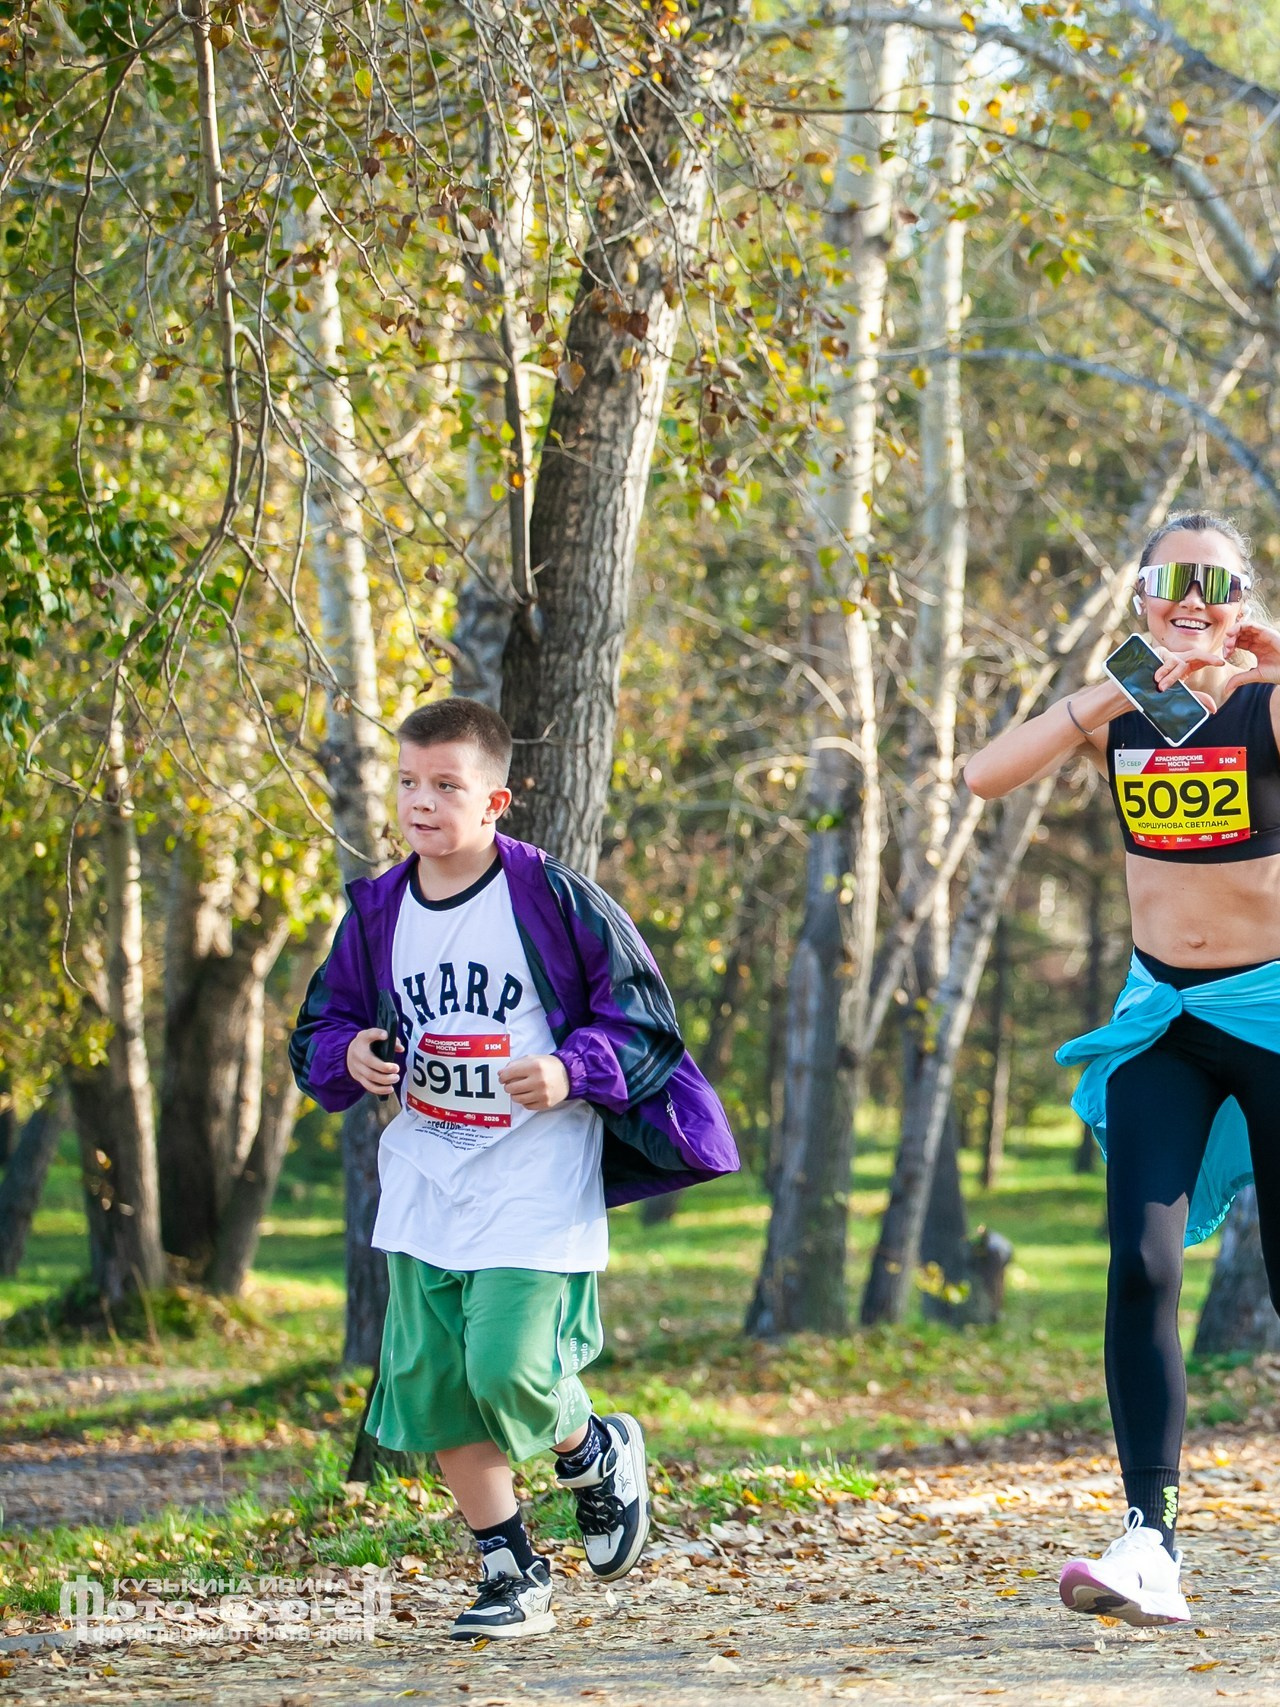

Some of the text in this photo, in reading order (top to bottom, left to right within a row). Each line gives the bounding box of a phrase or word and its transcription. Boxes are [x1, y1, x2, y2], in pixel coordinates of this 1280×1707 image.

[1123, 778, 1241, 818] 5092
[1185, 820, 1230, 829] СВЕТЛАНА
[412, 1051, 496, 1100] 5911
